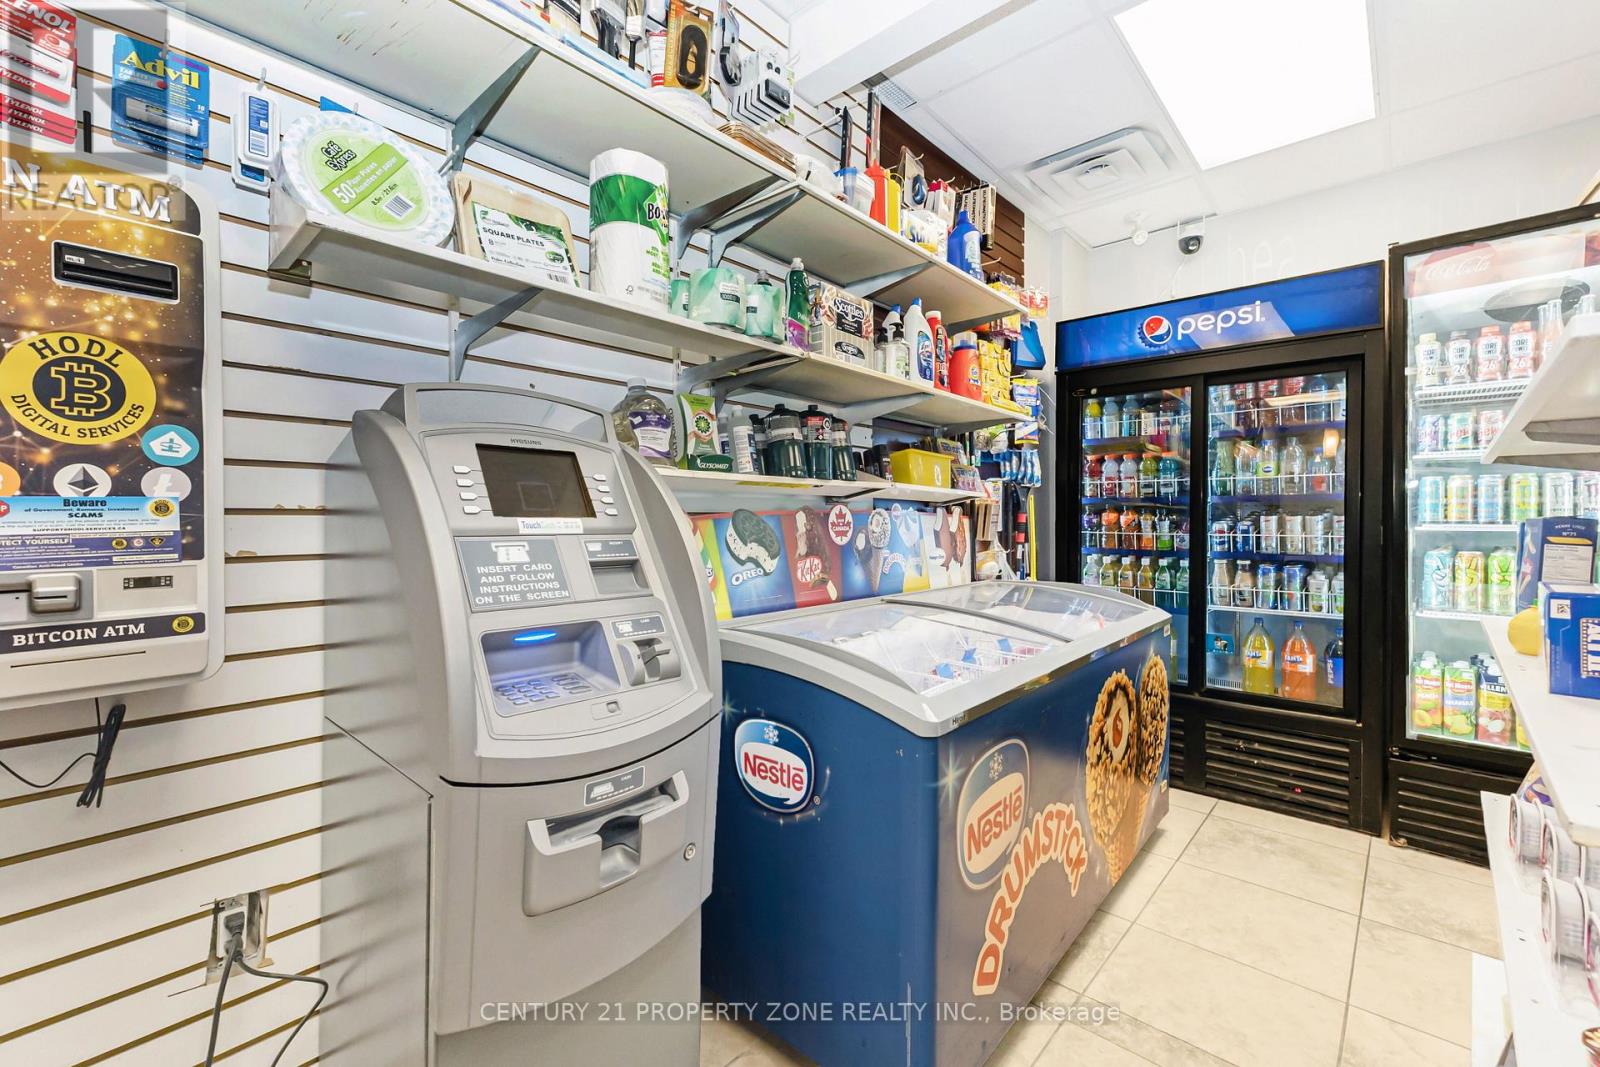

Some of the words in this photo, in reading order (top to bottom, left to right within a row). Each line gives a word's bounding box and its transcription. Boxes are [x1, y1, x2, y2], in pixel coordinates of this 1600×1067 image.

[122, 50, 199, 89] Advil
[5, 95, 44, 116] TYLENOL
[7, 117, 45, 134] TYLENOL
[8, 109, 46, 125] TYLENOL
[60, 174, 172, 223] ATM
[331, 182, 357, 204] 50
[482, 227, 516, 240] SQUARE
[516, 235, 545, 247] PLATES
[835, 298, 864, 319] Scotties
[1177, 300, 1264, 340] pepsi
[28, 335, 124, 368] HODL
[11, 394, 71, 437] DIGITAL
[77, 402, 146, 439] SERVICES
[700, 462, 730, 470] GLYSOMED
[63, 499, 107, 507] Beware
[476, 565, 517, 574] INSERT
[523, 563, 553, 572] CARD
[480, 575, 505, 584] AND
[510, 572, 555, 582] FOLLOW
[731, 568, 764, 587] OREO
[475, 596, 494, 605] ON
[499, 594, 521, 603] THE
[526, 590, 570, 601] SCREEN
[480, 581, 560, 594] INSTRUCTIONS
[12, 627, 98, 647] BITCOIN
[103, 623, 146, 638] ATM
[744, 752, 804, 792] Nestlé
[965, 786, 1024, 862] Nestlé
